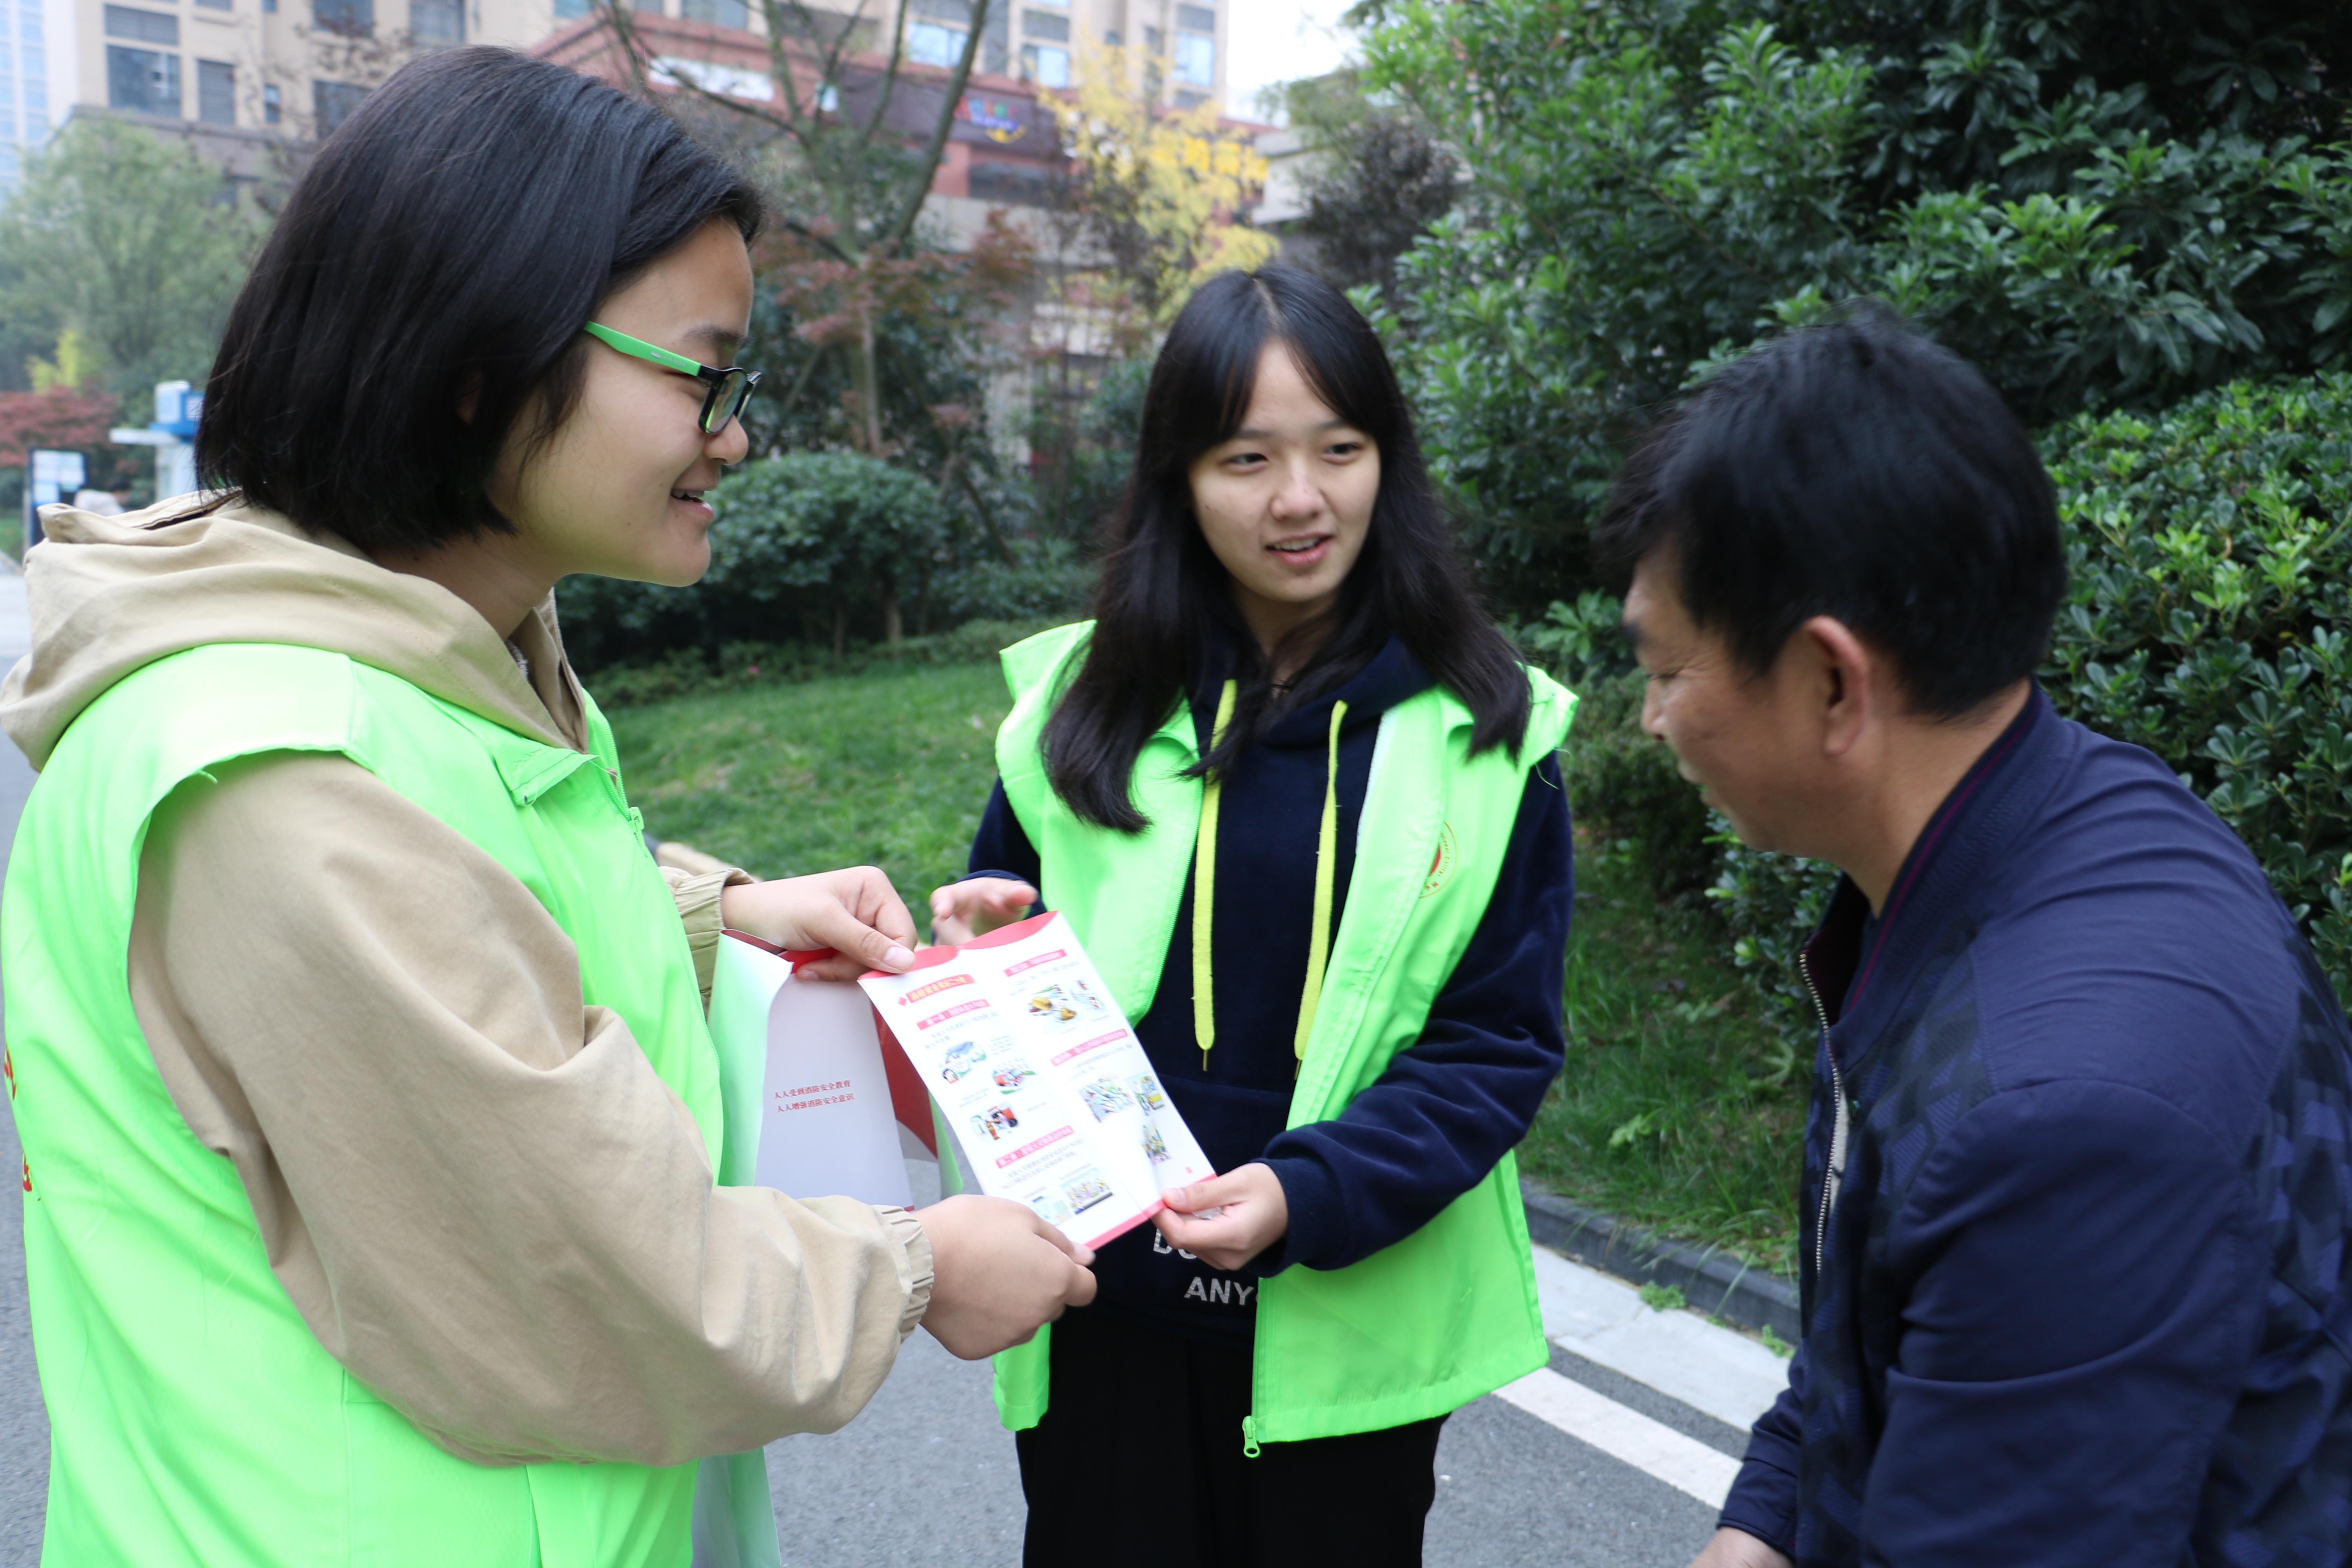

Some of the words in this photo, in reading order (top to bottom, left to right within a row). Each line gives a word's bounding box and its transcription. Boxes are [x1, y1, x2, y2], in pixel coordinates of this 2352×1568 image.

[774, 1080, 851, 1099] 人人受到消防安全教育
[777, 1093, 855, 1113] 人人增强消防安全意识
[1184, 1276, 1258, 1305] ANY
